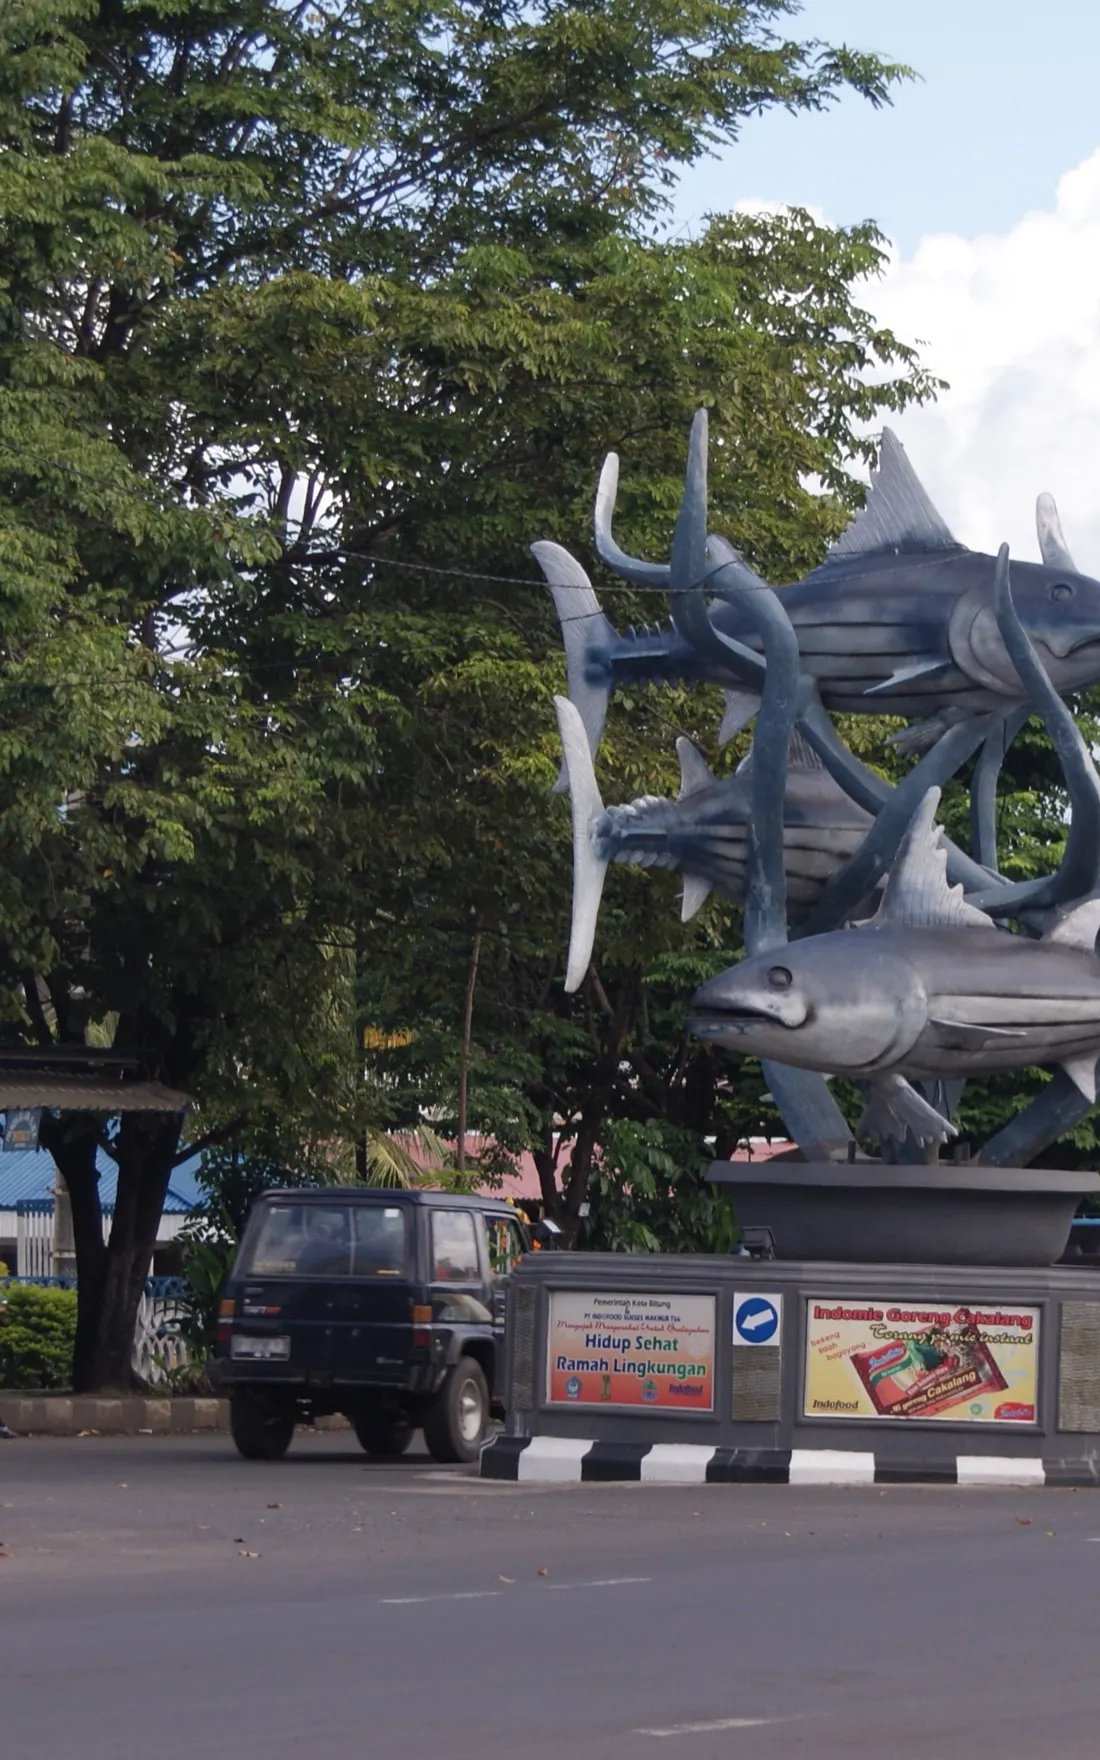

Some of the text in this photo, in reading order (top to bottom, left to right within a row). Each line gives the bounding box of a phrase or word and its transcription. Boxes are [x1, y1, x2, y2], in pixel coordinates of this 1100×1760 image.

[593, 1298, 671, 1309] Pemerintah Kota Bitung
[814, 1305, 1033, 1330] Indomie Goreng Cakalang
[585, 1334, 679, 1353] Hidup Sehat
[810, 1331, 841, 1348] bekeng
[556, 1356, 706, 1379] Ramah Lingkungan
[927, 1370, 976, 1398] Cakalang
[812, 1399, 859, 1411] Indofood
